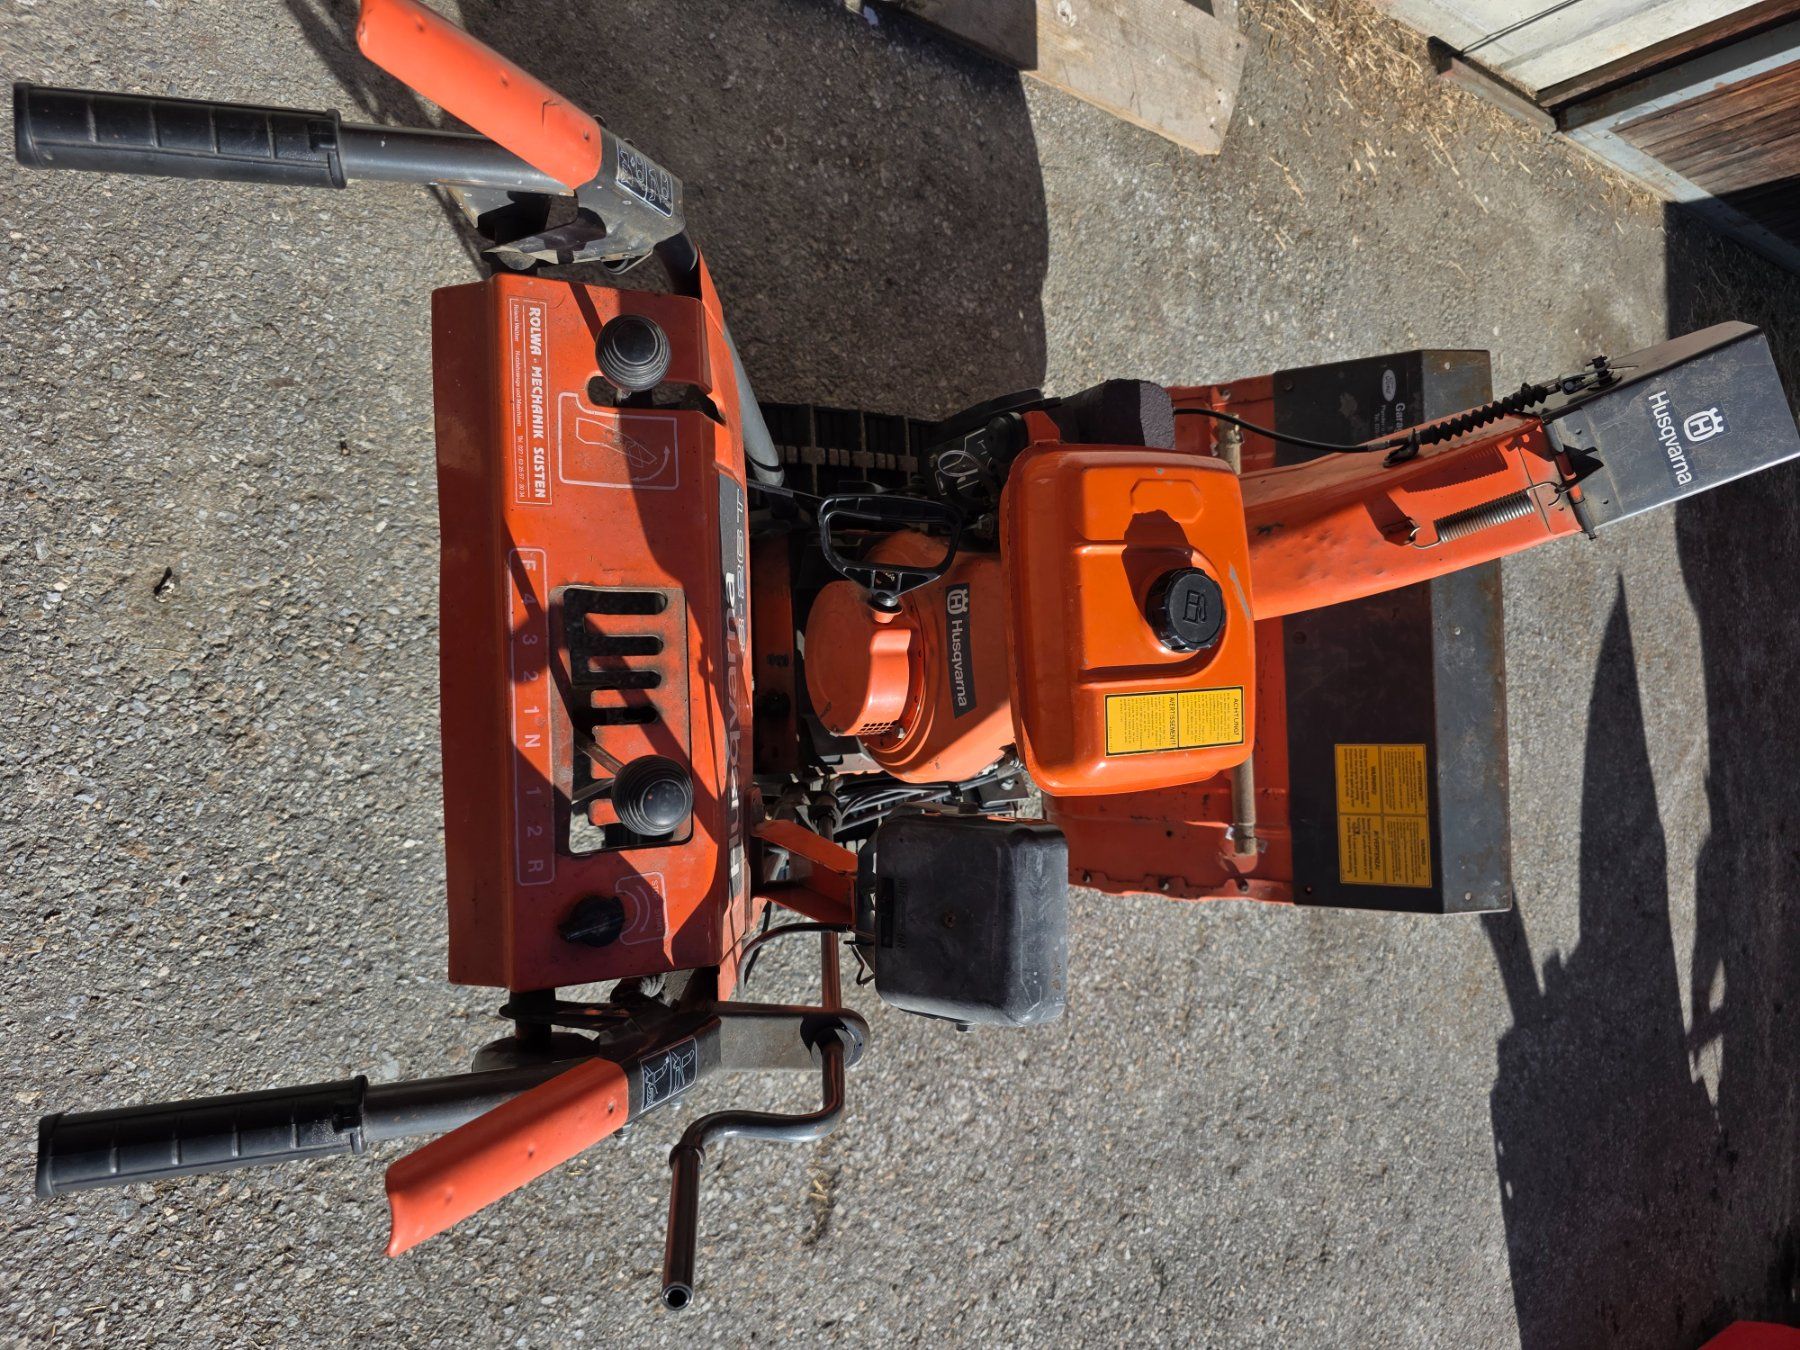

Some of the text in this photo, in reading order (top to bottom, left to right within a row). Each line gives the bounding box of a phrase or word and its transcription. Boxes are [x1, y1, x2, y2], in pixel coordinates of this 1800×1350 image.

[528, 307, 542, 355] ROLWA
[530, 365, 545, 439] MECHANIK
[1647, 390, 1693, 486] Husqvarna
[533, 446, 546, 499] SUSTEN
[951, 619, 968, 707] Husqvarna
[521, 559, 544, 873] F 4 3 2 1 N 1 2 R
[725, 572, 741, 879] Husqvarna
[1168, 696, 1176, 745] AVERTISSEMENT!
